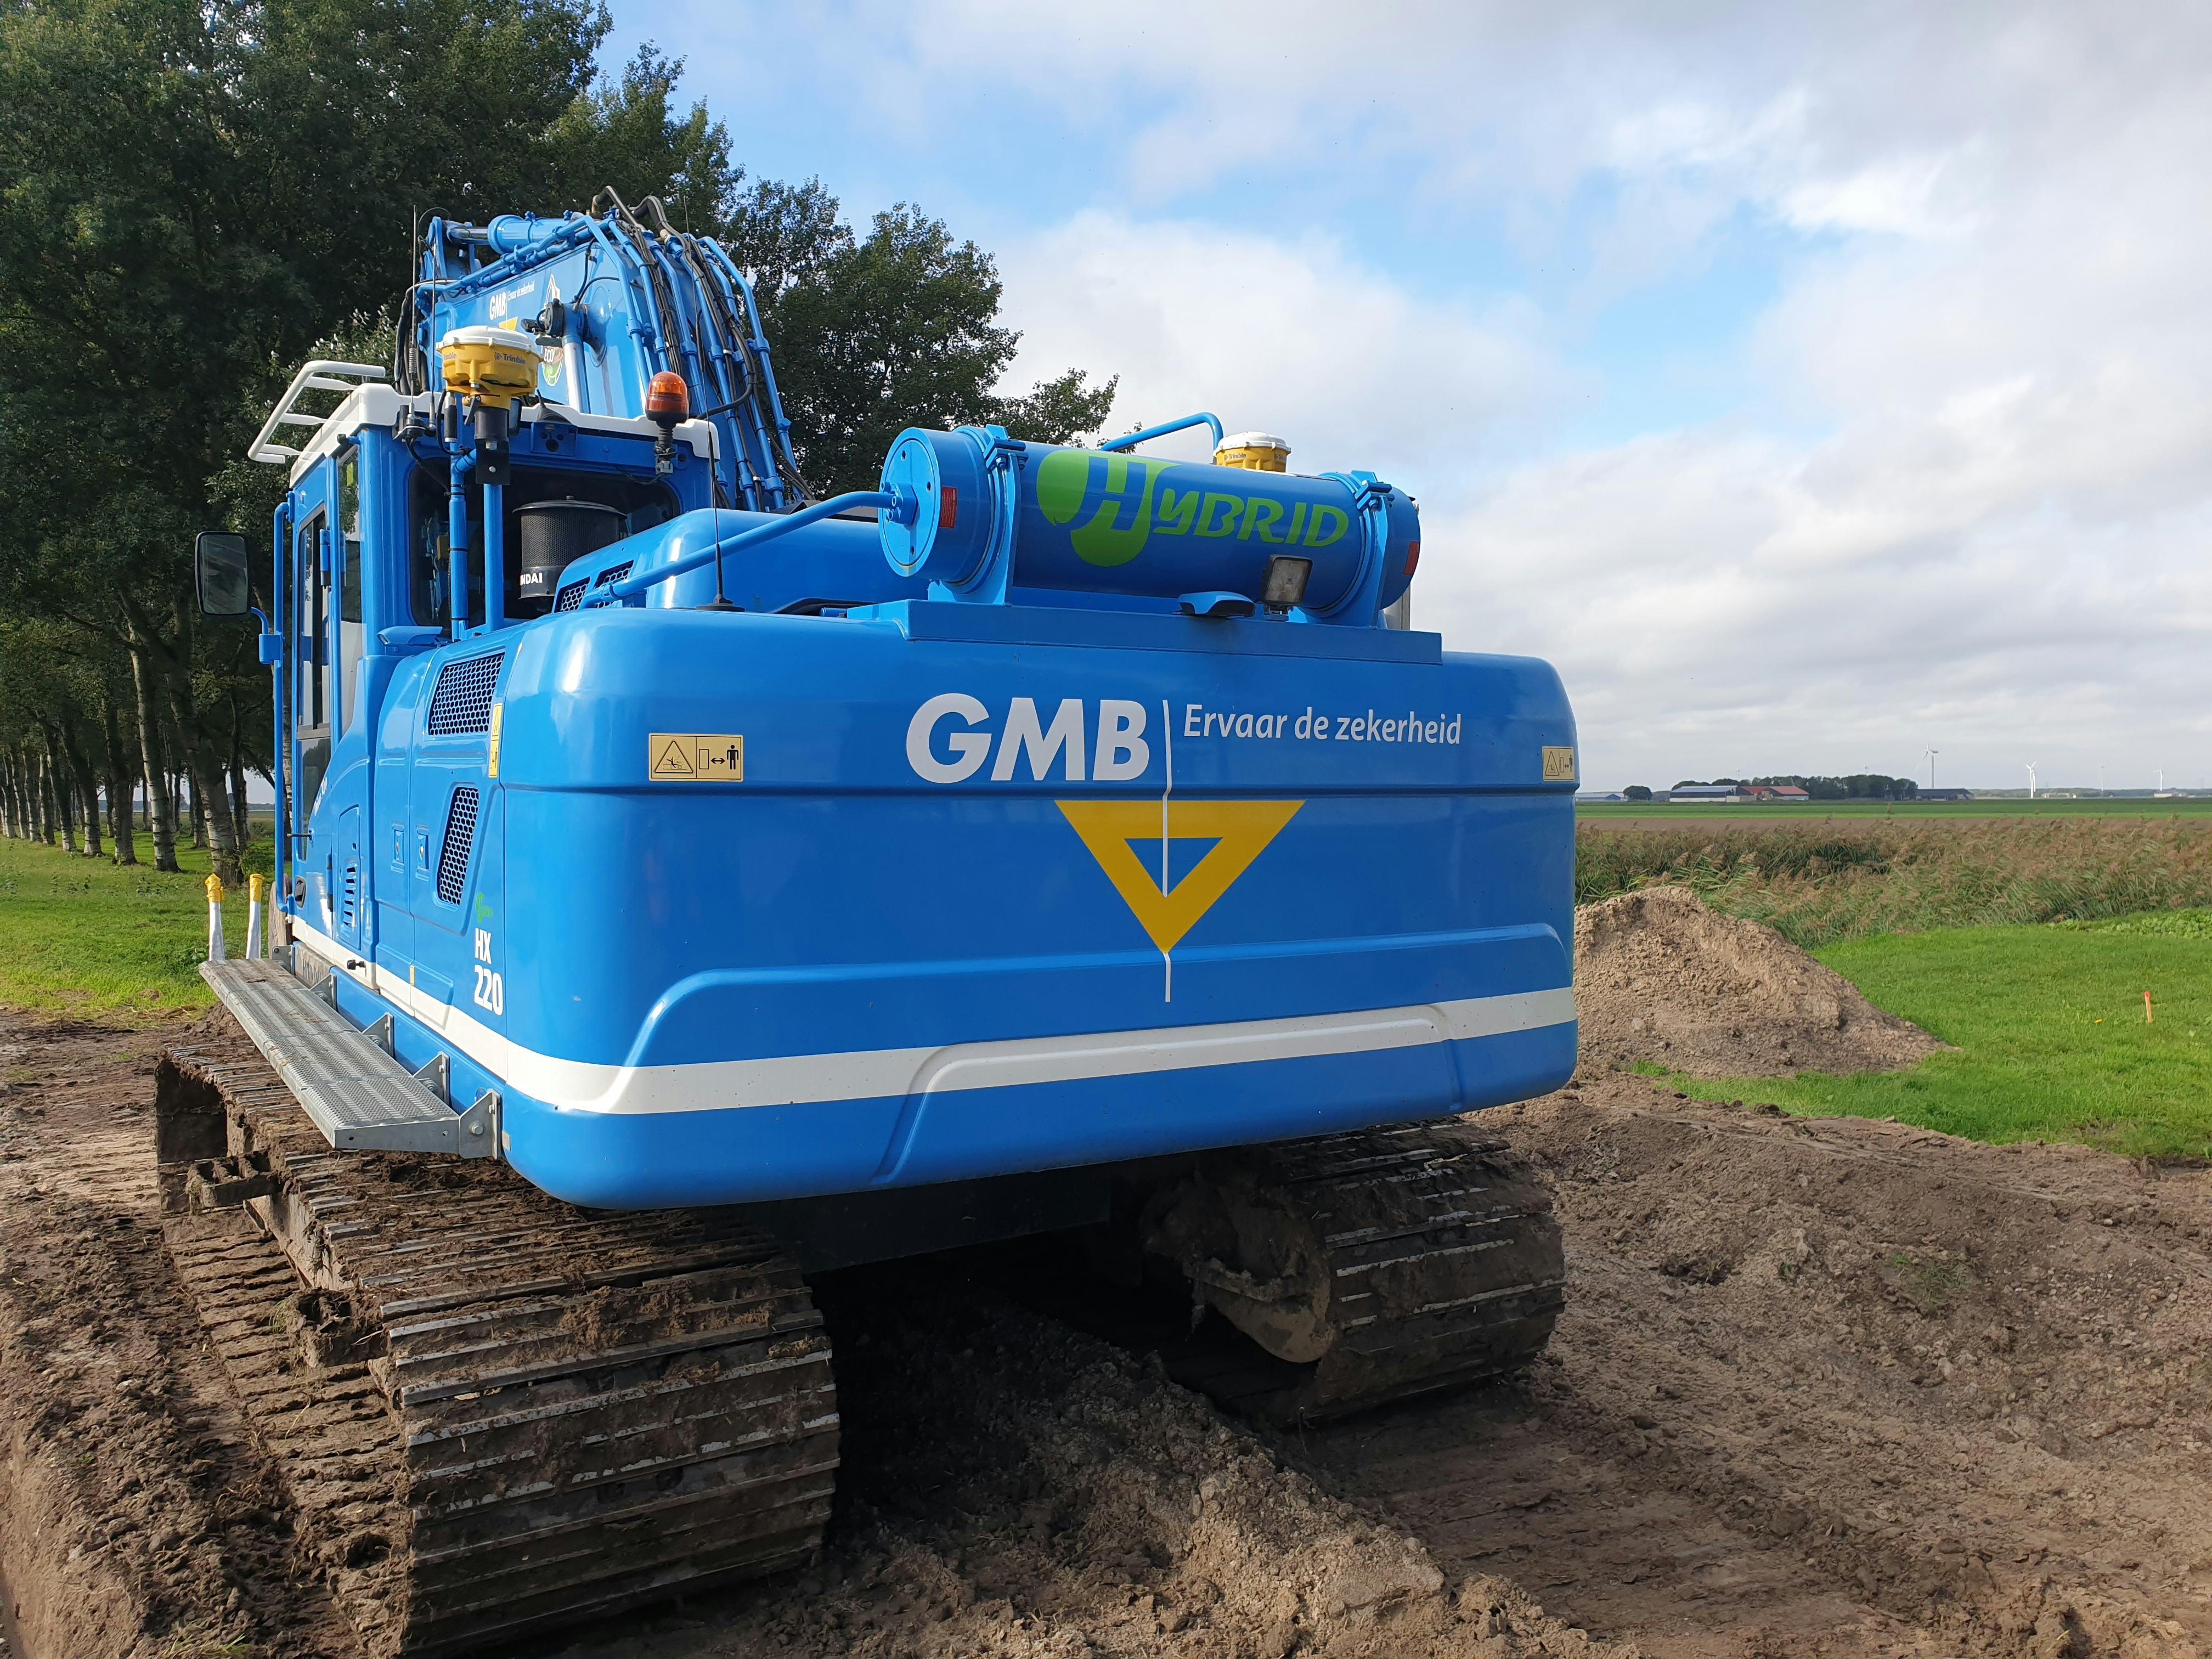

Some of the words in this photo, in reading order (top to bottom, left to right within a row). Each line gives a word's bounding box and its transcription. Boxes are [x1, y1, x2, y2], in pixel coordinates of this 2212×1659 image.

[489, 292, 506, 320] GMB
[503, 353, 526, 365] Trimble
[906, 693, 1150, 784] GMB
[1183, 704, 1288, 738] Ervaar
[1294, 707, 1328, 740] de
[1334, 709, 1461, 744] zekerheid
[475, 927, 492, 964] HX
[474, 964, 503, 1015] 220
